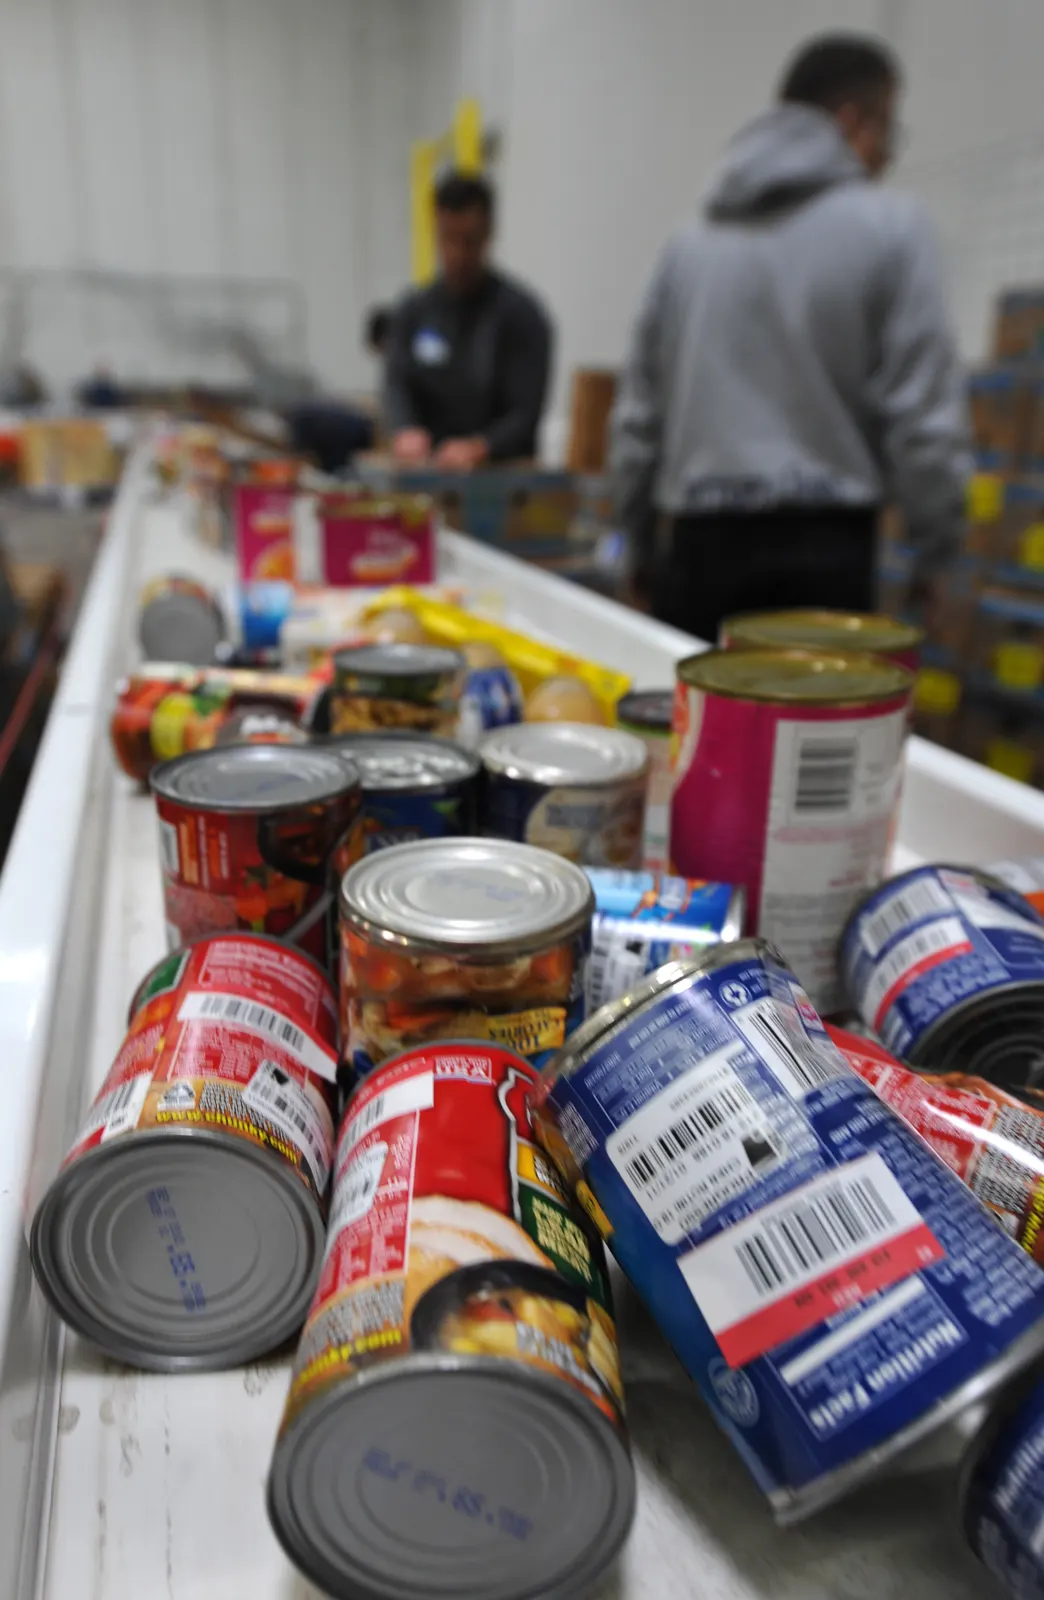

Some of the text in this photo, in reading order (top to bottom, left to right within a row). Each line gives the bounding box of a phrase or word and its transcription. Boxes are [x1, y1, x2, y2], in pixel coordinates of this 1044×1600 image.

[156, 1109, 297, 1165] www.chunky.com
[865, 1317, 962, 1392] Nutrition
[809, 1381, 872, 1431] Facts
